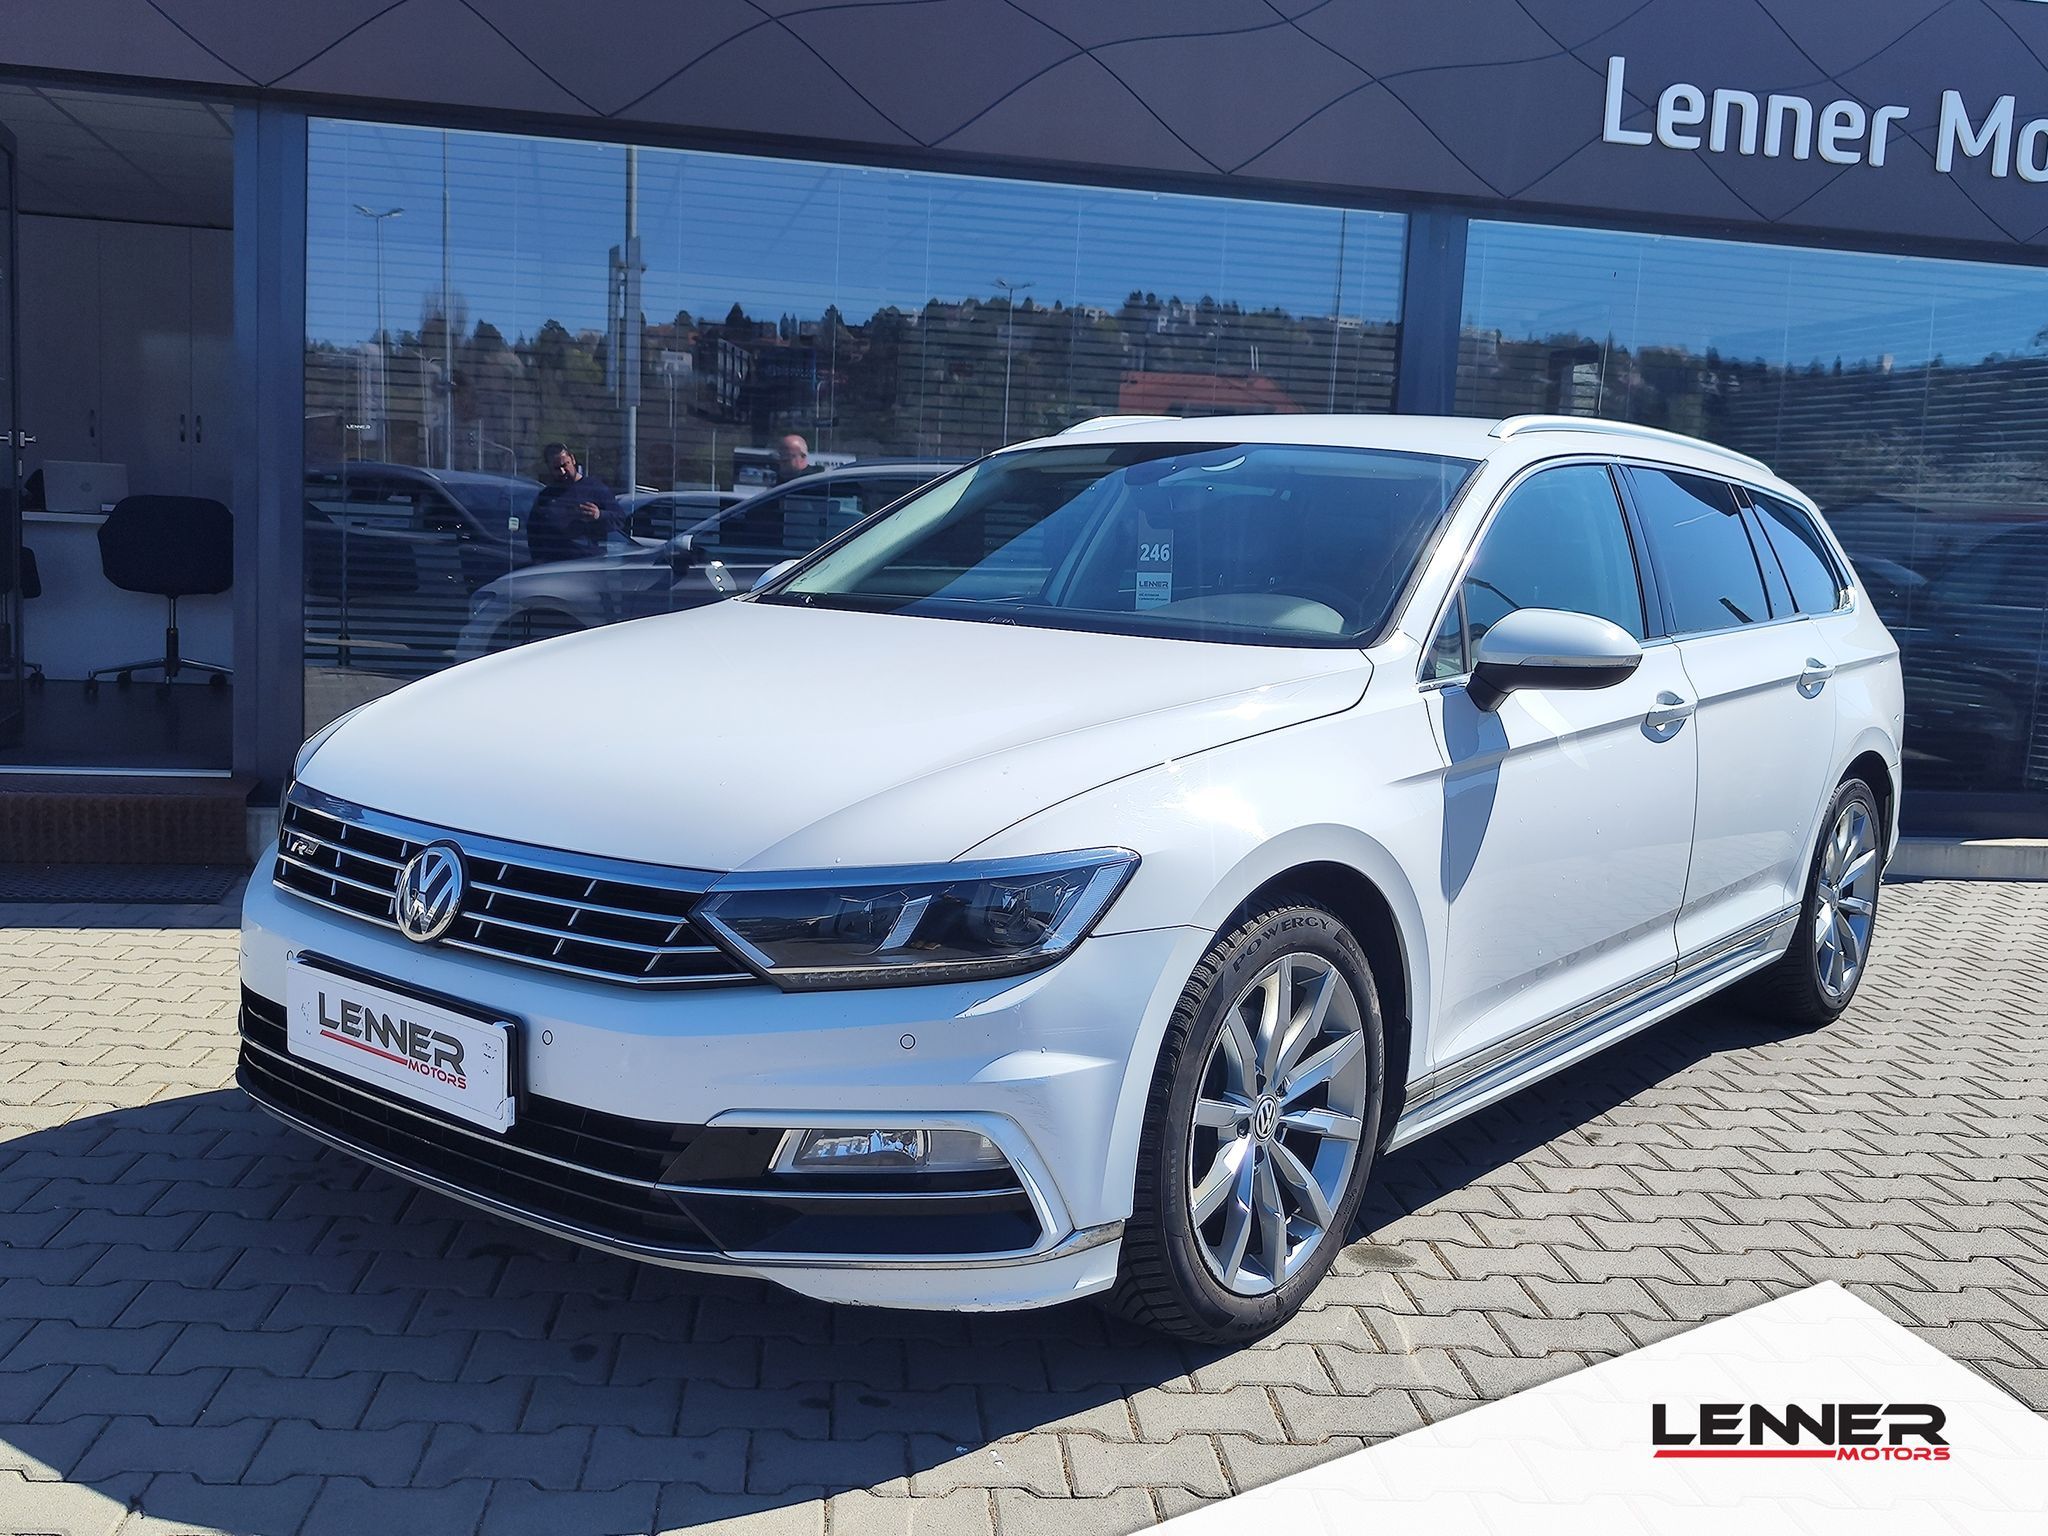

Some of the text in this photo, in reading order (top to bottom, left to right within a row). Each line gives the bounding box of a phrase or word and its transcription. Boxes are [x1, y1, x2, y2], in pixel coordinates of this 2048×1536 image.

[1603, 56, 2048, 184] Lenner Mo
[1139, 543, 1170, 562] 246
[1138, 580, 1169, 590] LENNER
[1232, 916, 1333, 973] POWERGY
[318, 991, 467, 1077] LENNER
[407, 1058, 467, 1090] MOTORS
